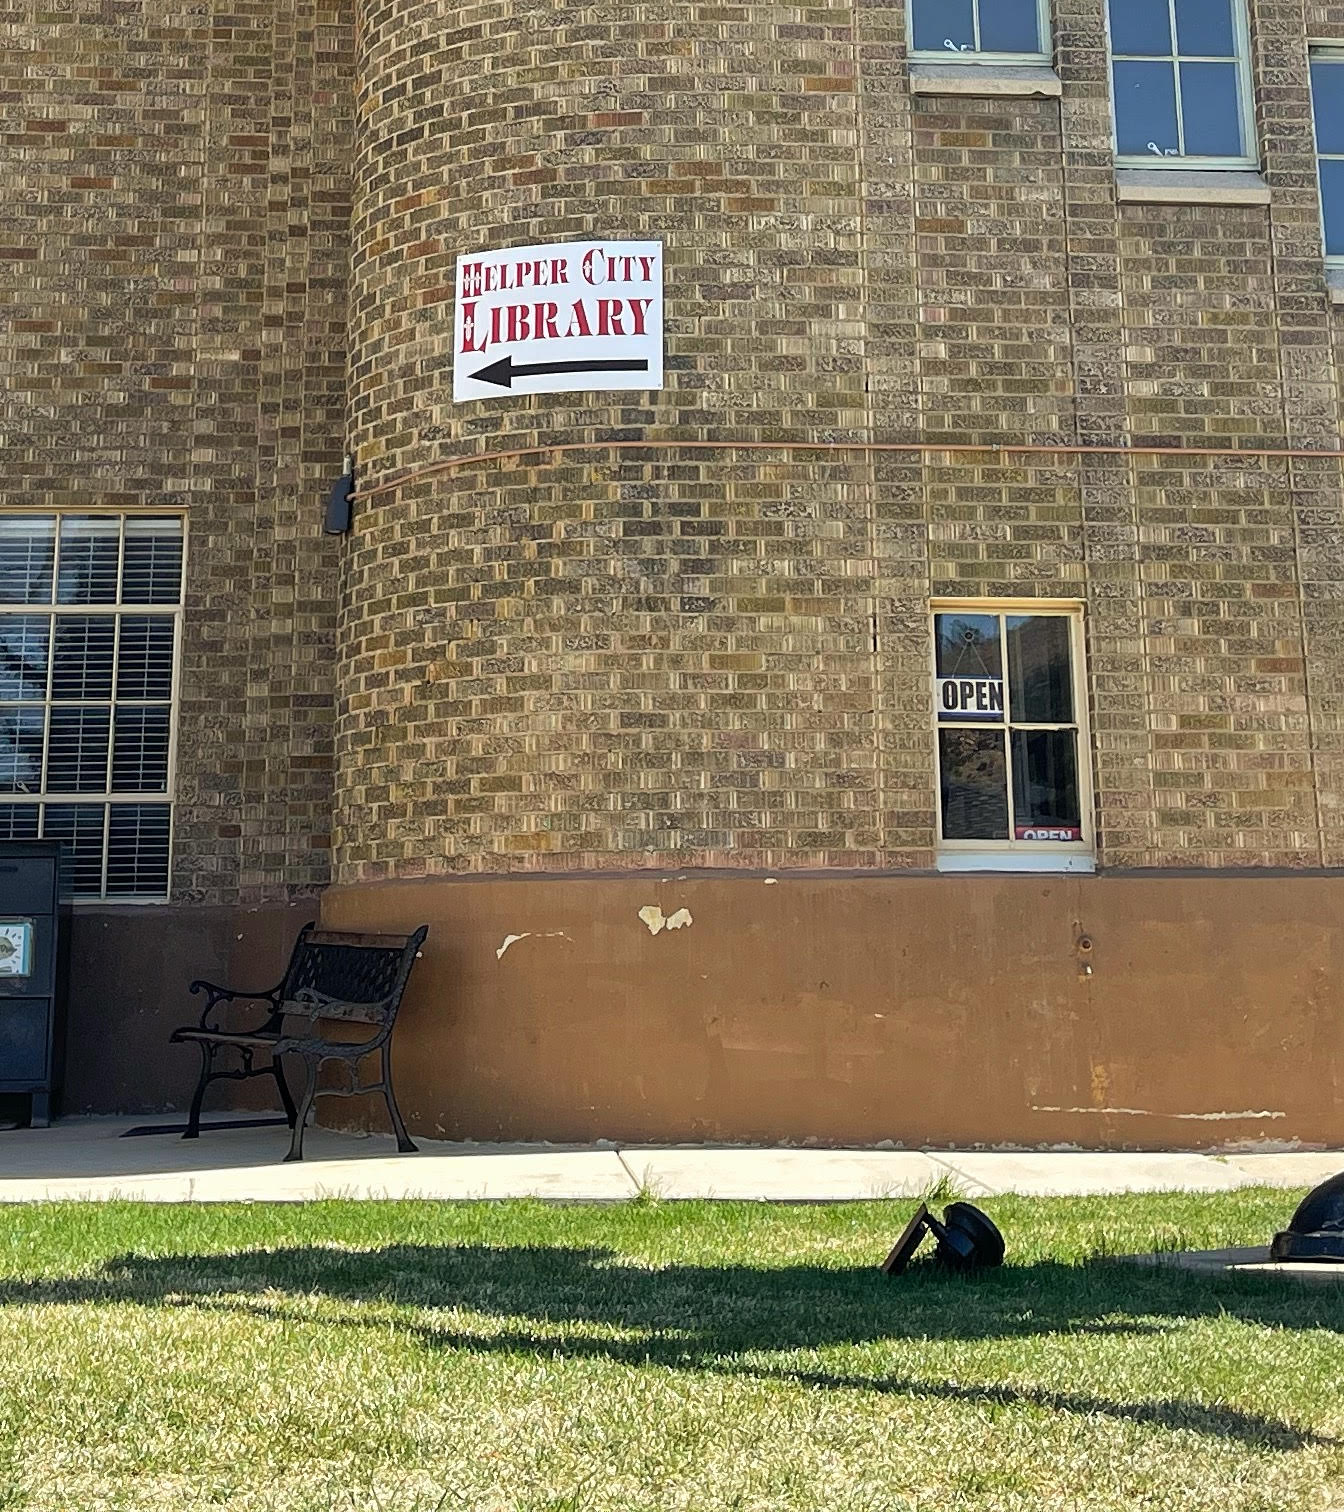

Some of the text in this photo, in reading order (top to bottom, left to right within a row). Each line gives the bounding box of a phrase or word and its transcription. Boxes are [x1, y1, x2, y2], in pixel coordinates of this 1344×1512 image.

[460, 247, 656, 299] HELPER CITY
[459, 298, 654, 354] LIBRARY
[942, 680, 1004, 711] OPEN
[1023, 829, 1073, 840] OPEN
